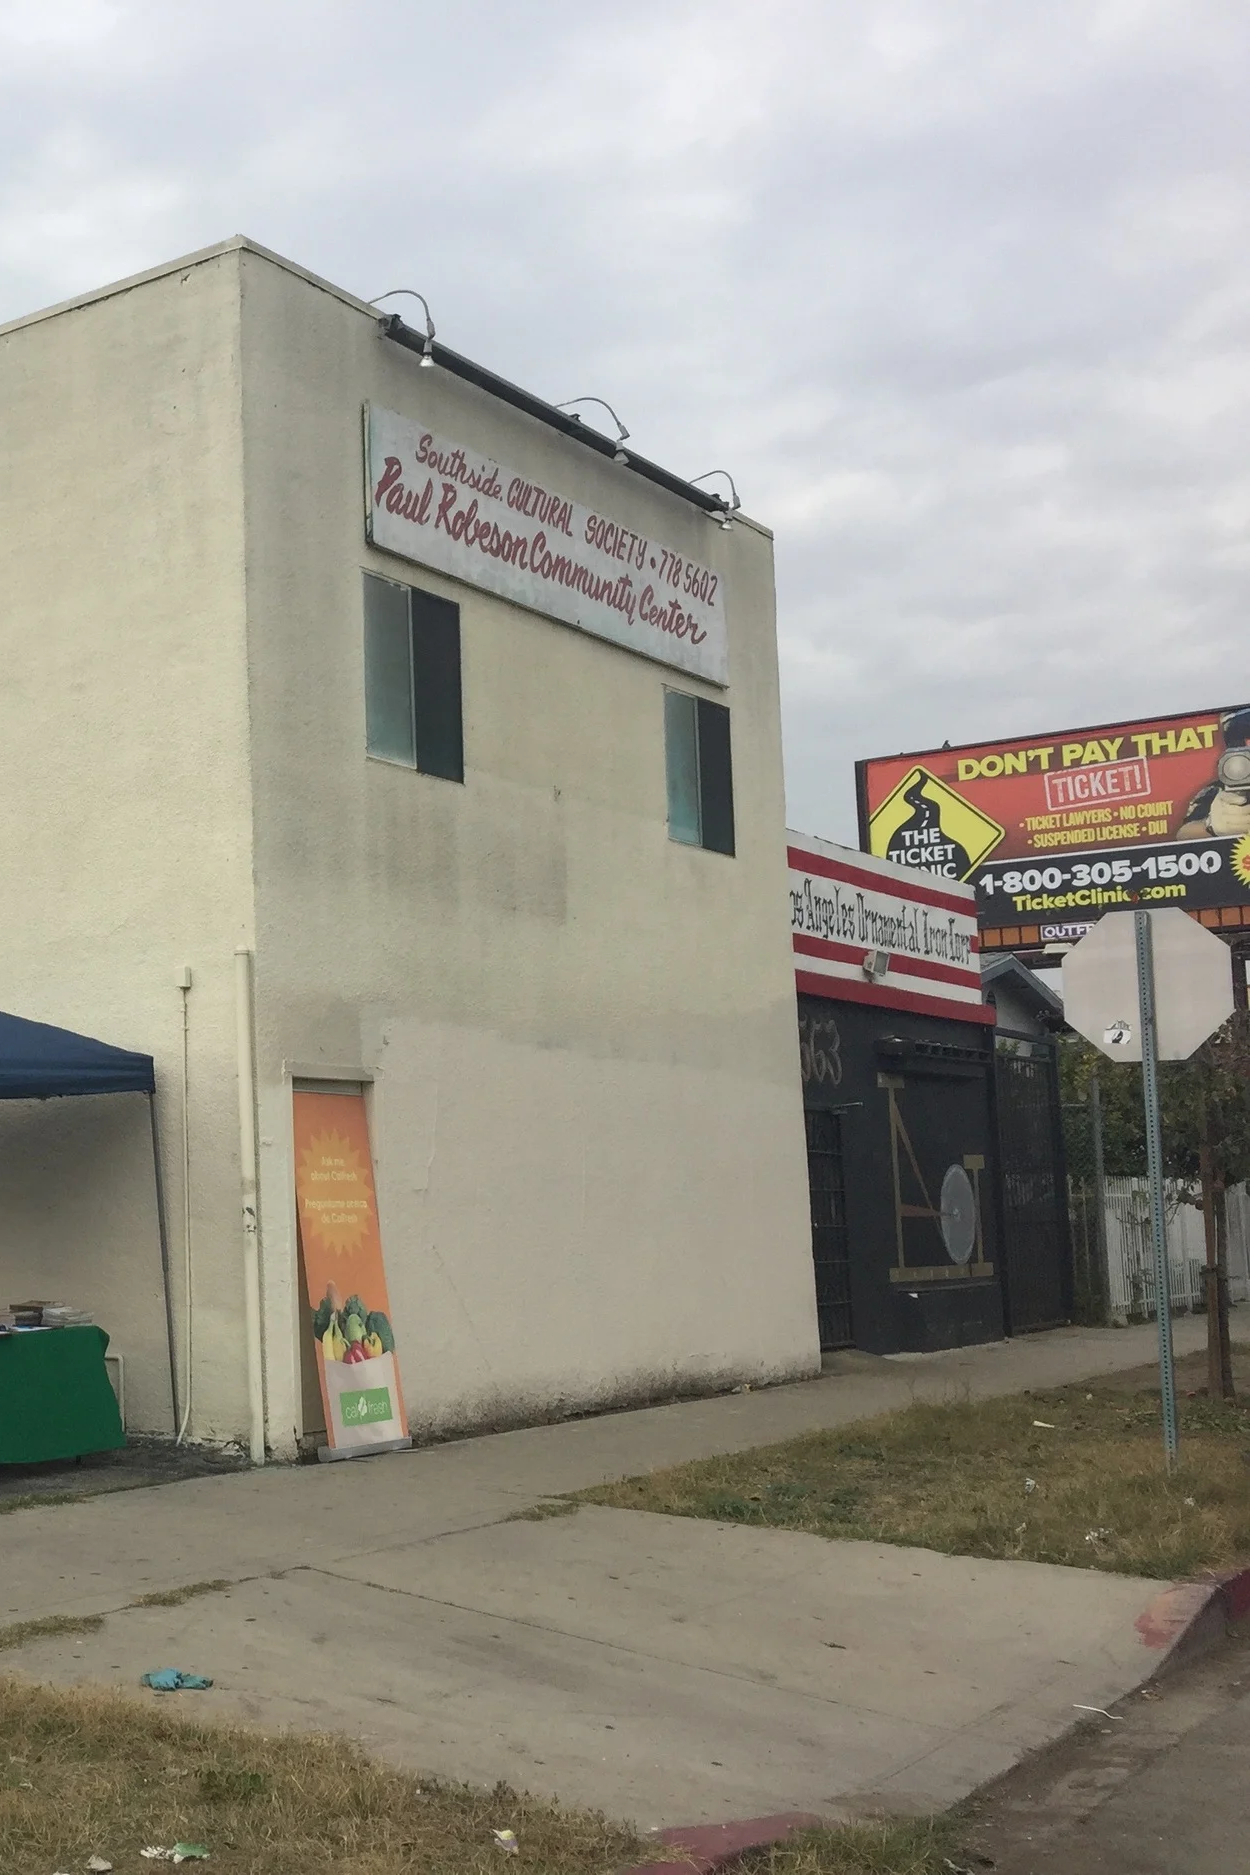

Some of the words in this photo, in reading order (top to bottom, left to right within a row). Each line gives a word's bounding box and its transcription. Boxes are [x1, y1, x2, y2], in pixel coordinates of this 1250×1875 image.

[507, 477, 573, 537] CULTURAL
[585, 515, 647, 571] SOCIETY
[375, 456, 434, 526] Paul
[434, 482, 528, 571] Robeson
[529, 531, 638, 626] Community
[638, 584, 707, 645] Center
[957, 747, 1054, 781] DON'T
[1062, 736, 1125, 767] PAY
[1130, 724, 1219, 757] THAT
[1052, 764, 1143, 804] TICKET!
[901, 827, 940, 846] THE
[1025, 814, 1061, 831] TICKET
[1063, 808, 1112, 827] LAWYERS
[1119, 805, 1136, 820] NO
[1137, 800, 1173, 818] COURT
[1033, 828, 1096, 848] SUSPENDED
[1096, 823, 1141, 841] LICENSE
[1148, 820, 1167, 835] DUI
[888, 844, 956, 865] TICKET
[979, 850, 1222, 896] 1-800-305-1500
[804, 878, 855, 940] Angeles
[855, 891, 920, 954] Ornamental
[922, 910, 948, 960] Iron
